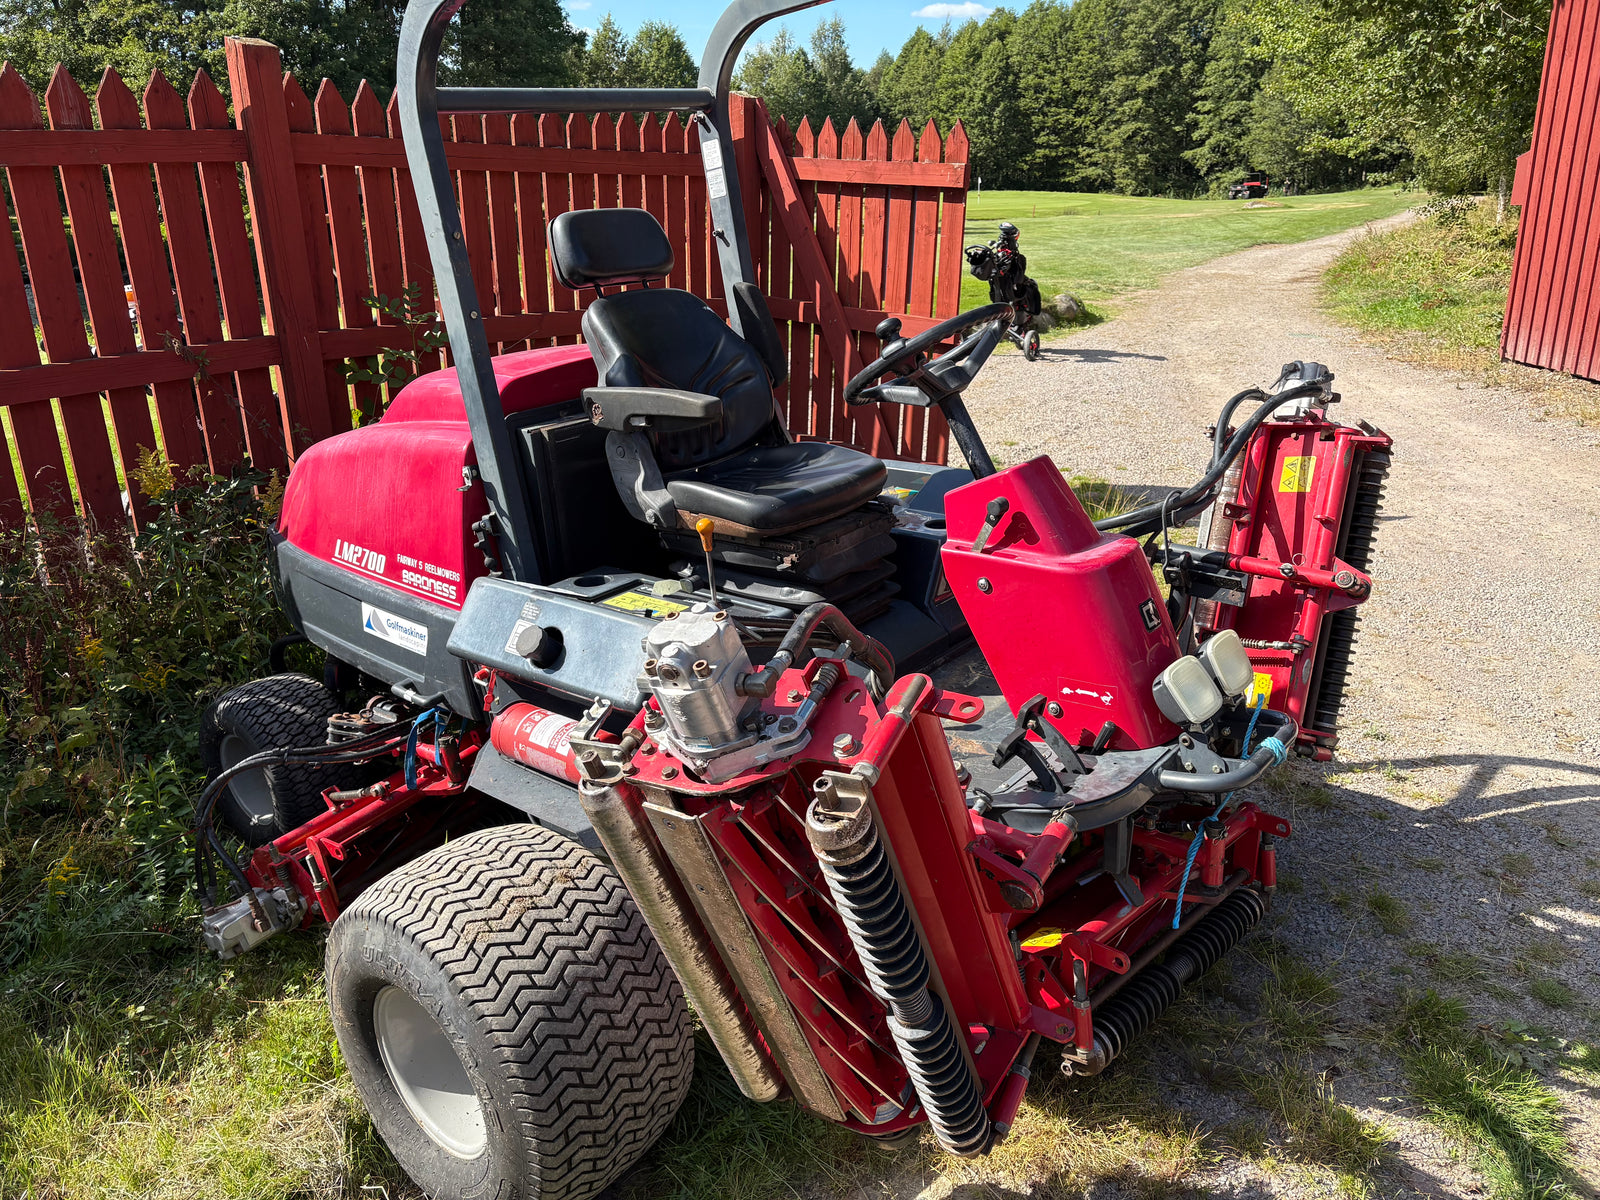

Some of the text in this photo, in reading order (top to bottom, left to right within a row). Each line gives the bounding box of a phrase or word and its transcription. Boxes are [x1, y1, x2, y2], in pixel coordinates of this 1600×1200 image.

[334, 538, 386, 574] LM2700
[397, 553, 418, 569] FAIRWAY
[424, 563, 461, 582] REELMOWERS
[402, 569, 457, 600] BARONESS
[386, 618, 427, 641] Golfmaskiner
